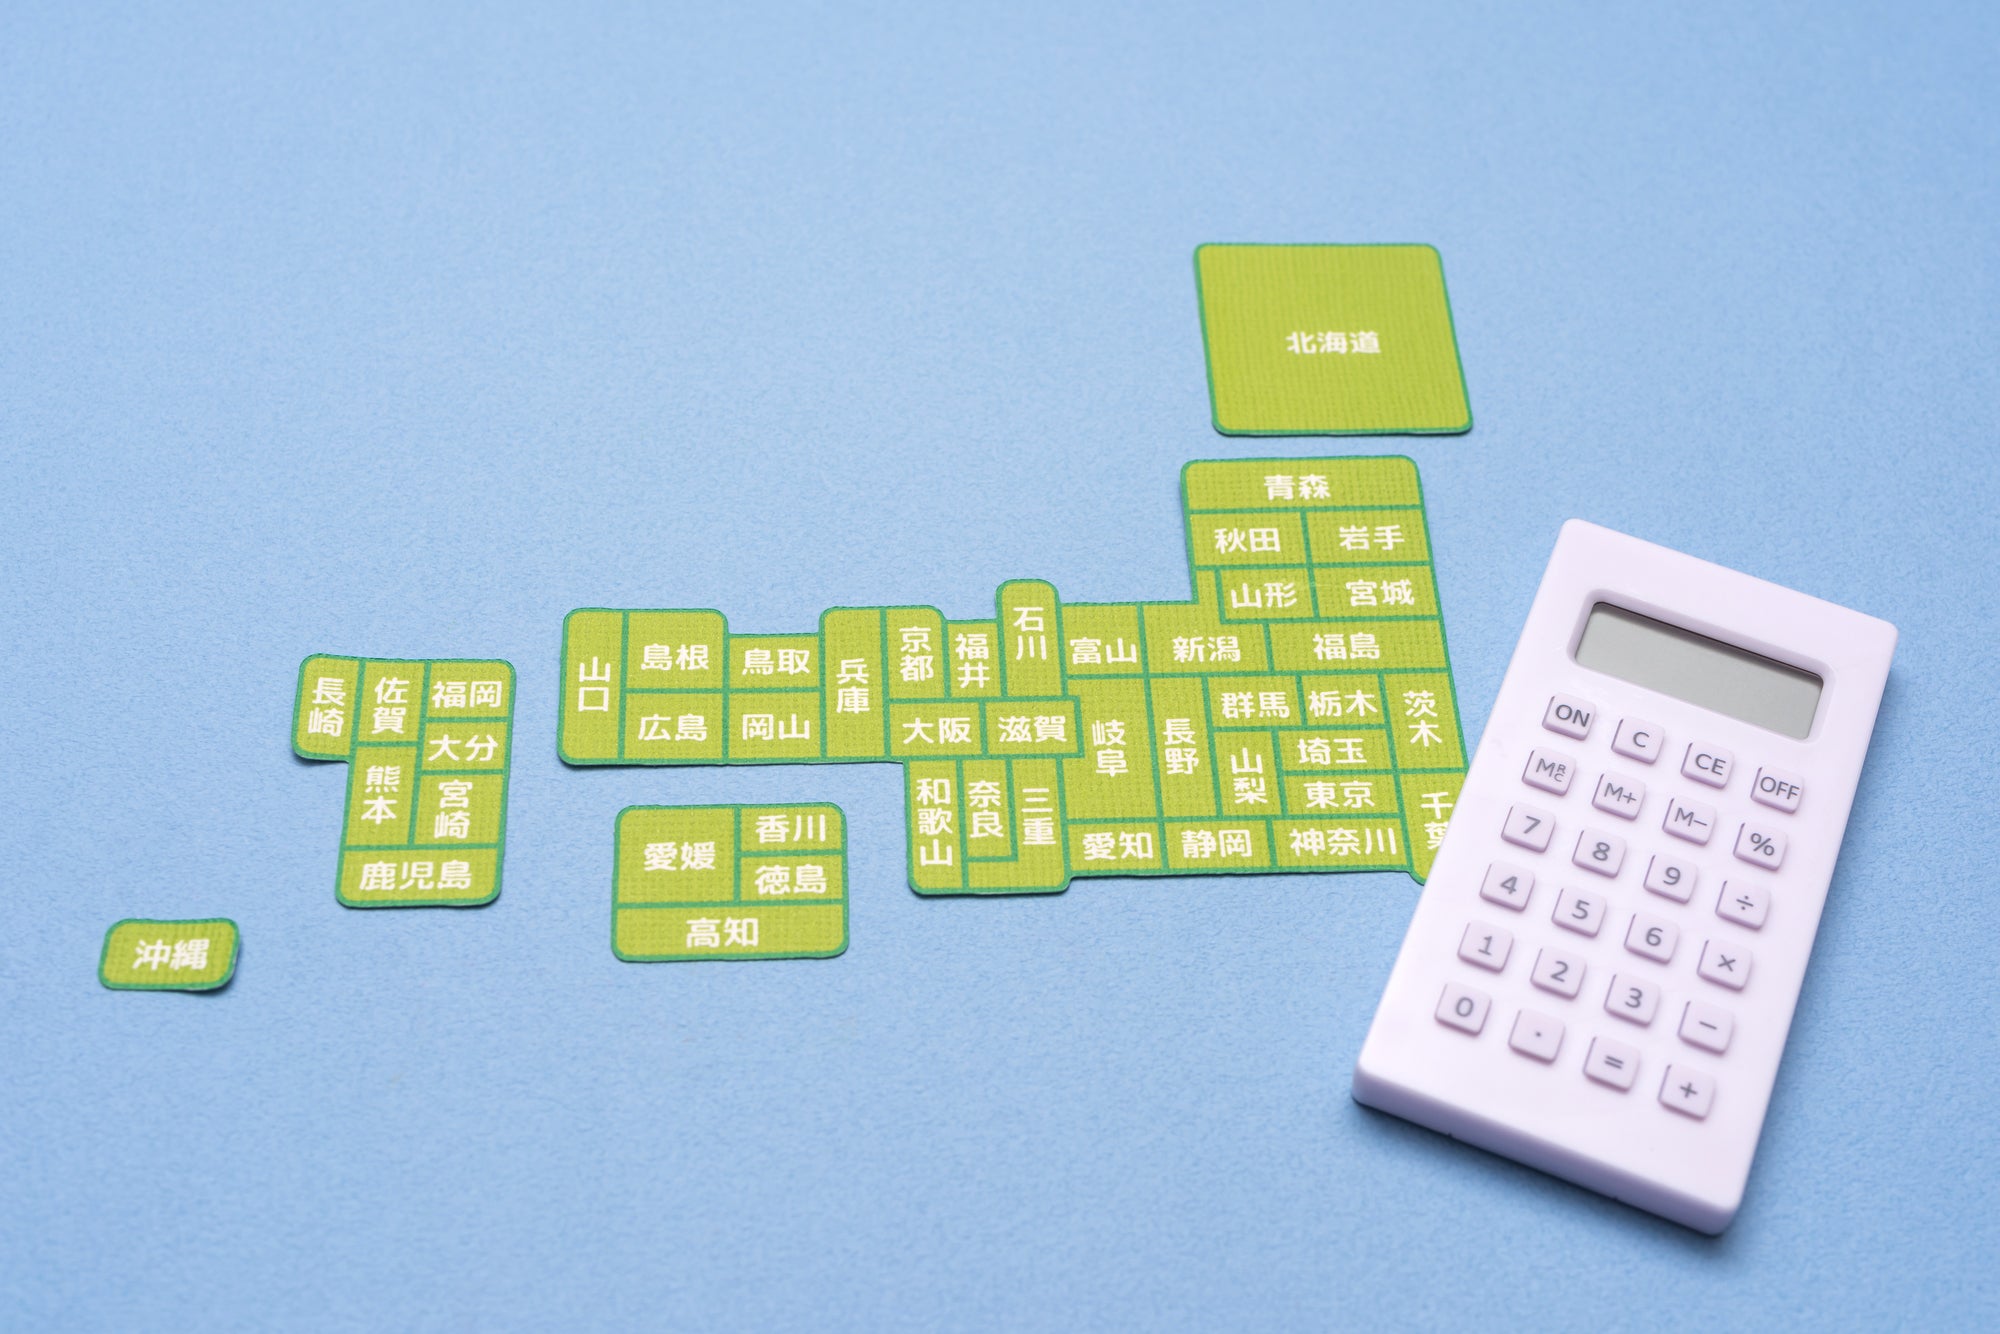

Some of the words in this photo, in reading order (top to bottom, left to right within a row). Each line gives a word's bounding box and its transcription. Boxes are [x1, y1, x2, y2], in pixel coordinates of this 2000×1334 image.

[1285, 330, 1381, 355] 北海道
[1263, 473, 1331, 501] 青森
[1214, 527, 1281, 555] 秋田
[1338, 524, 1405, 551] 岩手
[1230, 582, 1298, 609] 山形
[1345, 578, 1415, 607] 宮城
[1012, 606, 1048, 661] 石川
[1312, 631, 1381, 661] 福島
[640, 642, 710, 671] 島根
[741, 647, 811, 676] 鳥取
[898, 625, 934, 682] 京都
[954, 632, 991, 689] 福井
[1069, 636, 1138, 665] 富山
[1172, 635, 1241, 664] 新潟
[431, 680, 503, 709] 福岡
[577, 656, 611, 713] 山口
[835, 657, 871, 715] 兵庫
[307, 676, 347, 738] 長崎
[371, 676, 410, 735] 佐賀
[1220, 691, 1291, 719] 群馬
[1307, 689, 1378, 718] 栃木
[1555, 704, 1590, 728] ON
[637, 713, 708, 742] 広島
[741, 713, 811, 741] 岡山
[902, 717, 972, 745] 大阪
[997, 715, 1068, 743] 滋賀
[1402, 689, 1443, 748] 茨木
[427, 733, 499, 762] 大分
[1091, 719, 1129, 778] 岐阜
[1162, 717, 1200, 775] 長野
[1296, 736, 1368, 766] 埼玉
[1632, 731, 1650, 748] C
[1230, 747, 1268, 805] 山梨
[1695, 753, 1727, 776] CE
[360, 765, 401, 825] 熊本
[1303, 780, 1375, 809] 東京
[1603, 782, 1637, 804] M+
[1759, 776, 1800, 800] OFF
[433, 779, 473, 840] 宮崎
[916, 777, 953, 867] 和歌山
[967, 779, 1004, 839] 奈良
[1021, 787, 1057, 846] 三重
[755, 814, 826, 844] 香川
[1523, 815, 1542, 835] 7
[643, 841, 716, 872] 愛媛
[1082, 831, 1154, 861] 愛知
[1180, 829, 1253, 859] 静岡
[1289, 827, 1397, 857] 神奈川
[1592, 841, 1611, 862] 8
[358, 859, 472, 891] 鹿児島
[754, 863, 827, 896] 徳島
[1499, 875, 1518, 895] 4
[1663, 866, 1681, 886] 9
[1571, 899, 1590, 920] 5
[685, 916, 759, 949] 高知
[1477, 935, 1493, 956] 1
[1645, 926, 1664, 947] 6
[132, 938, 210, 971] 沖縄
[1550, 960, 1569, 983] 2
[1454, 996, 1475, 1018] 0
[1625, 987, 1643, 1009] 3
